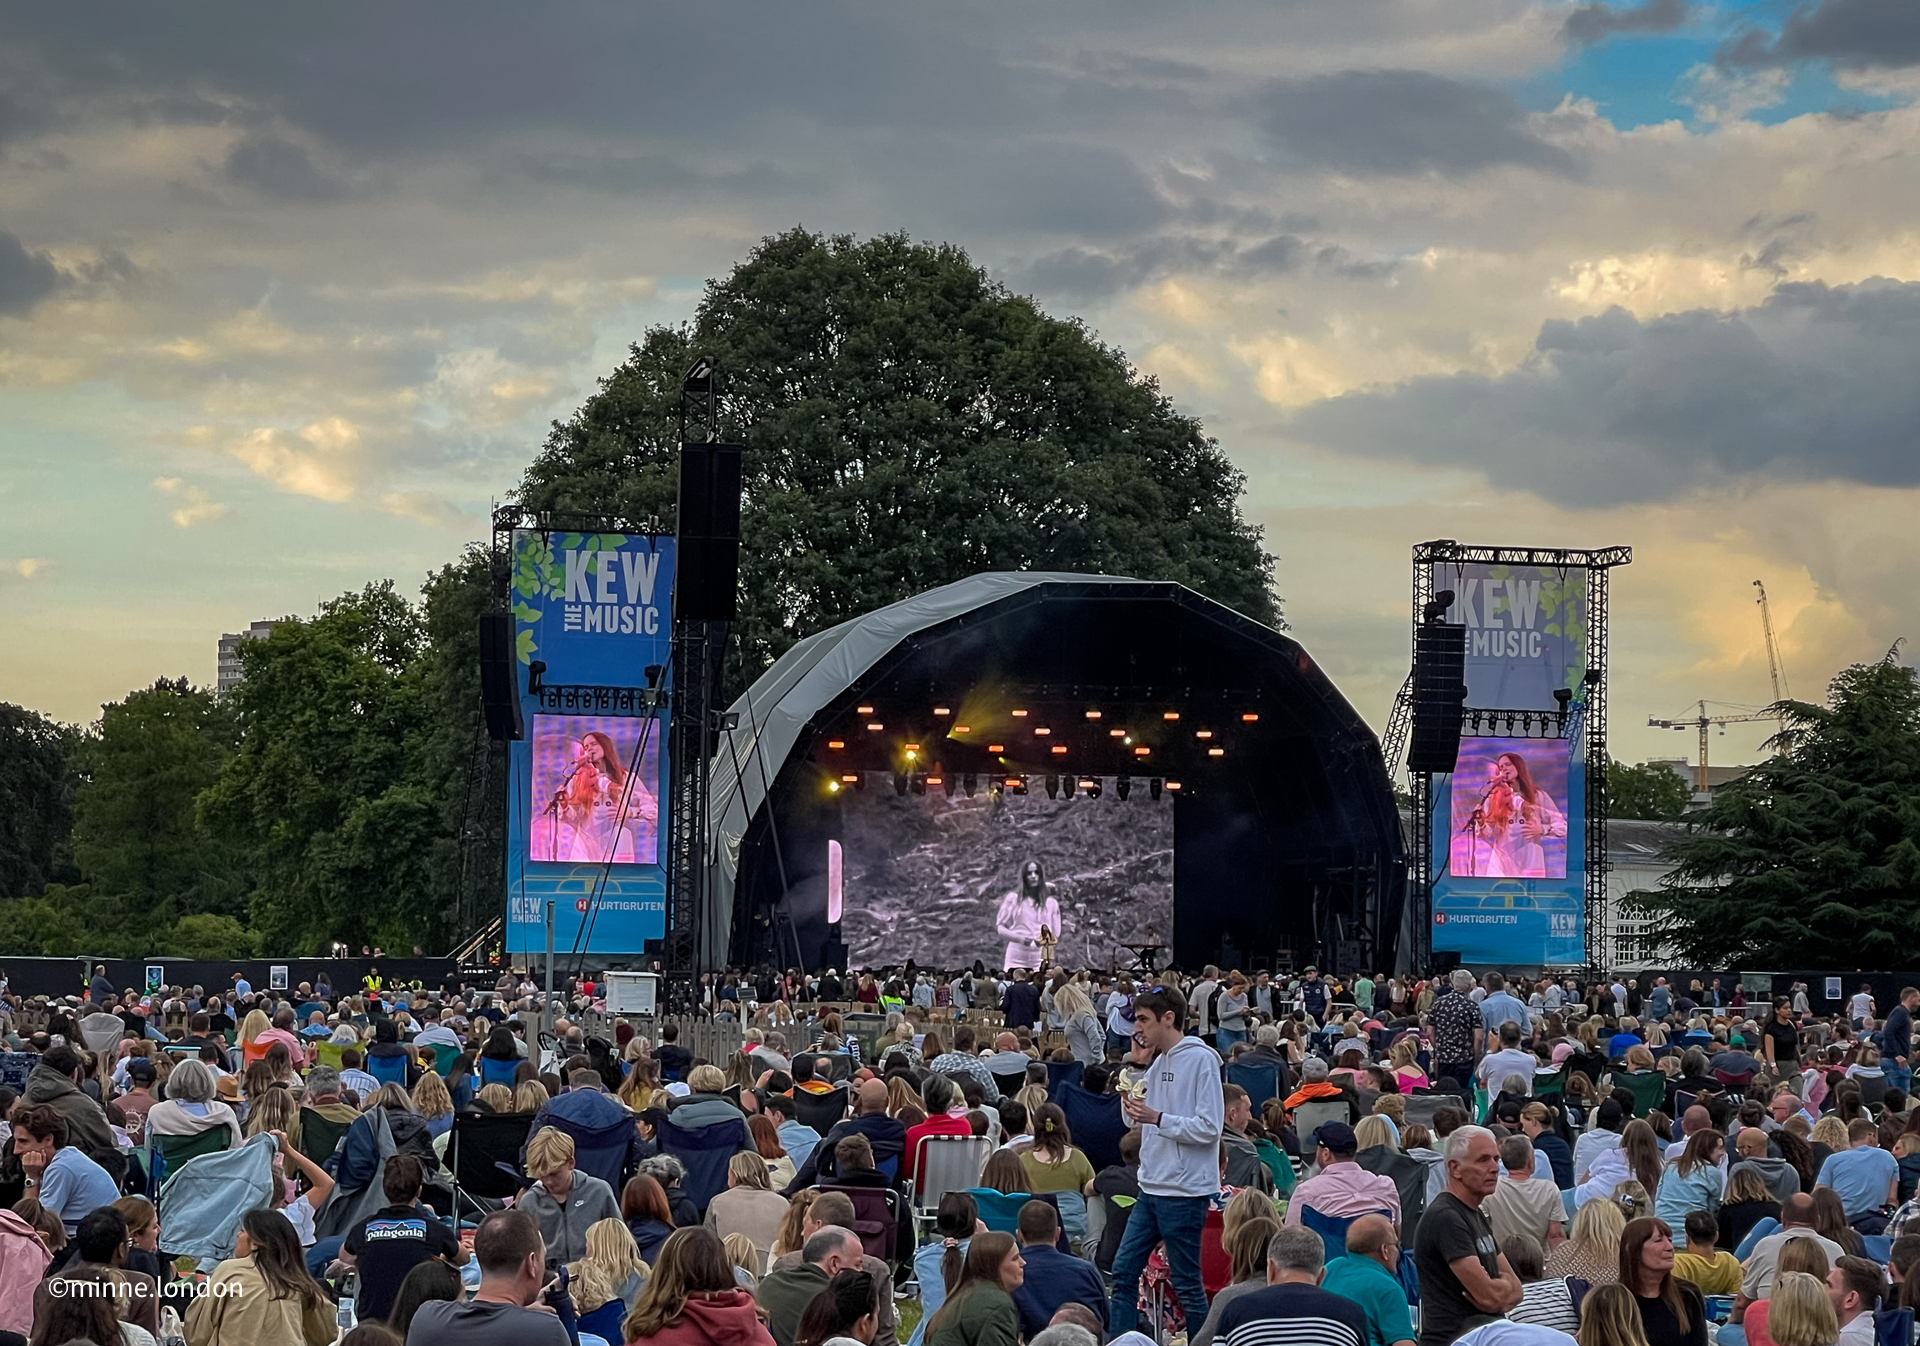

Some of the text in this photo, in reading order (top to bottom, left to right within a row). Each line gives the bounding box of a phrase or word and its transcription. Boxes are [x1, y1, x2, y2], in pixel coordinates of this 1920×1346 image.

[565, 549, 660, 605] KEW
[1453, 578, 1540, 629] KEW
[564, 604, 582, 631] THE
[584, 605, 659, 635] MUSIC
[1473, 630, 1542, 658] MUSIC
[511, 897, 541, 913] KEW
[591, 901, 665, 911] HURTIGRUTEN
[517, 914, 541, 923] MUSIC
[1449, 914, 1518, 924] HURTIGRUTEN
[1551, 913, 1577, 929] KEW
[367, 1228, 423, 1242] patagonia
